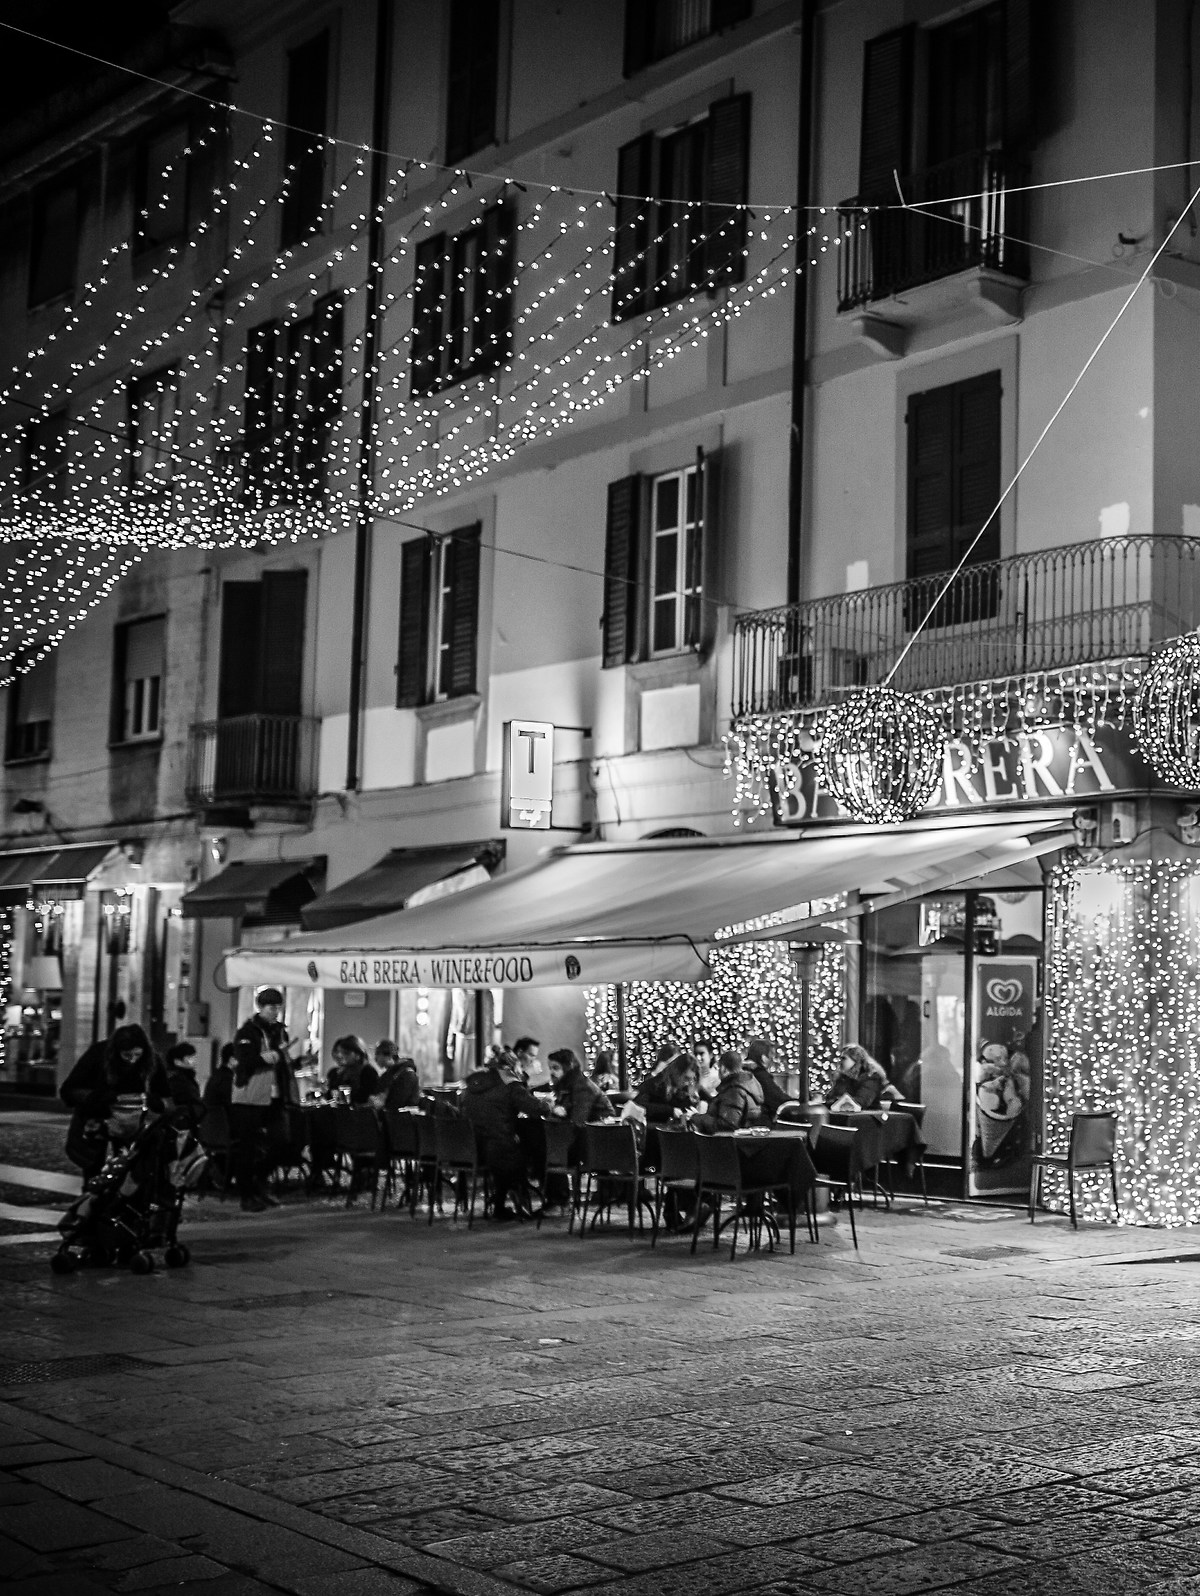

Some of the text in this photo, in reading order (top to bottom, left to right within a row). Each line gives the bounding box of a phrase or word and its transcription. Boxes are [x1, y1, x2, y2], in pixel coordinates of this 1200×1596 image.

[519, 730, 545, 774] T
[340, 957, 533, 984] BAR BRERA WINE&FOOD
[986, 1006, 1023, 1017] ALGIDA
